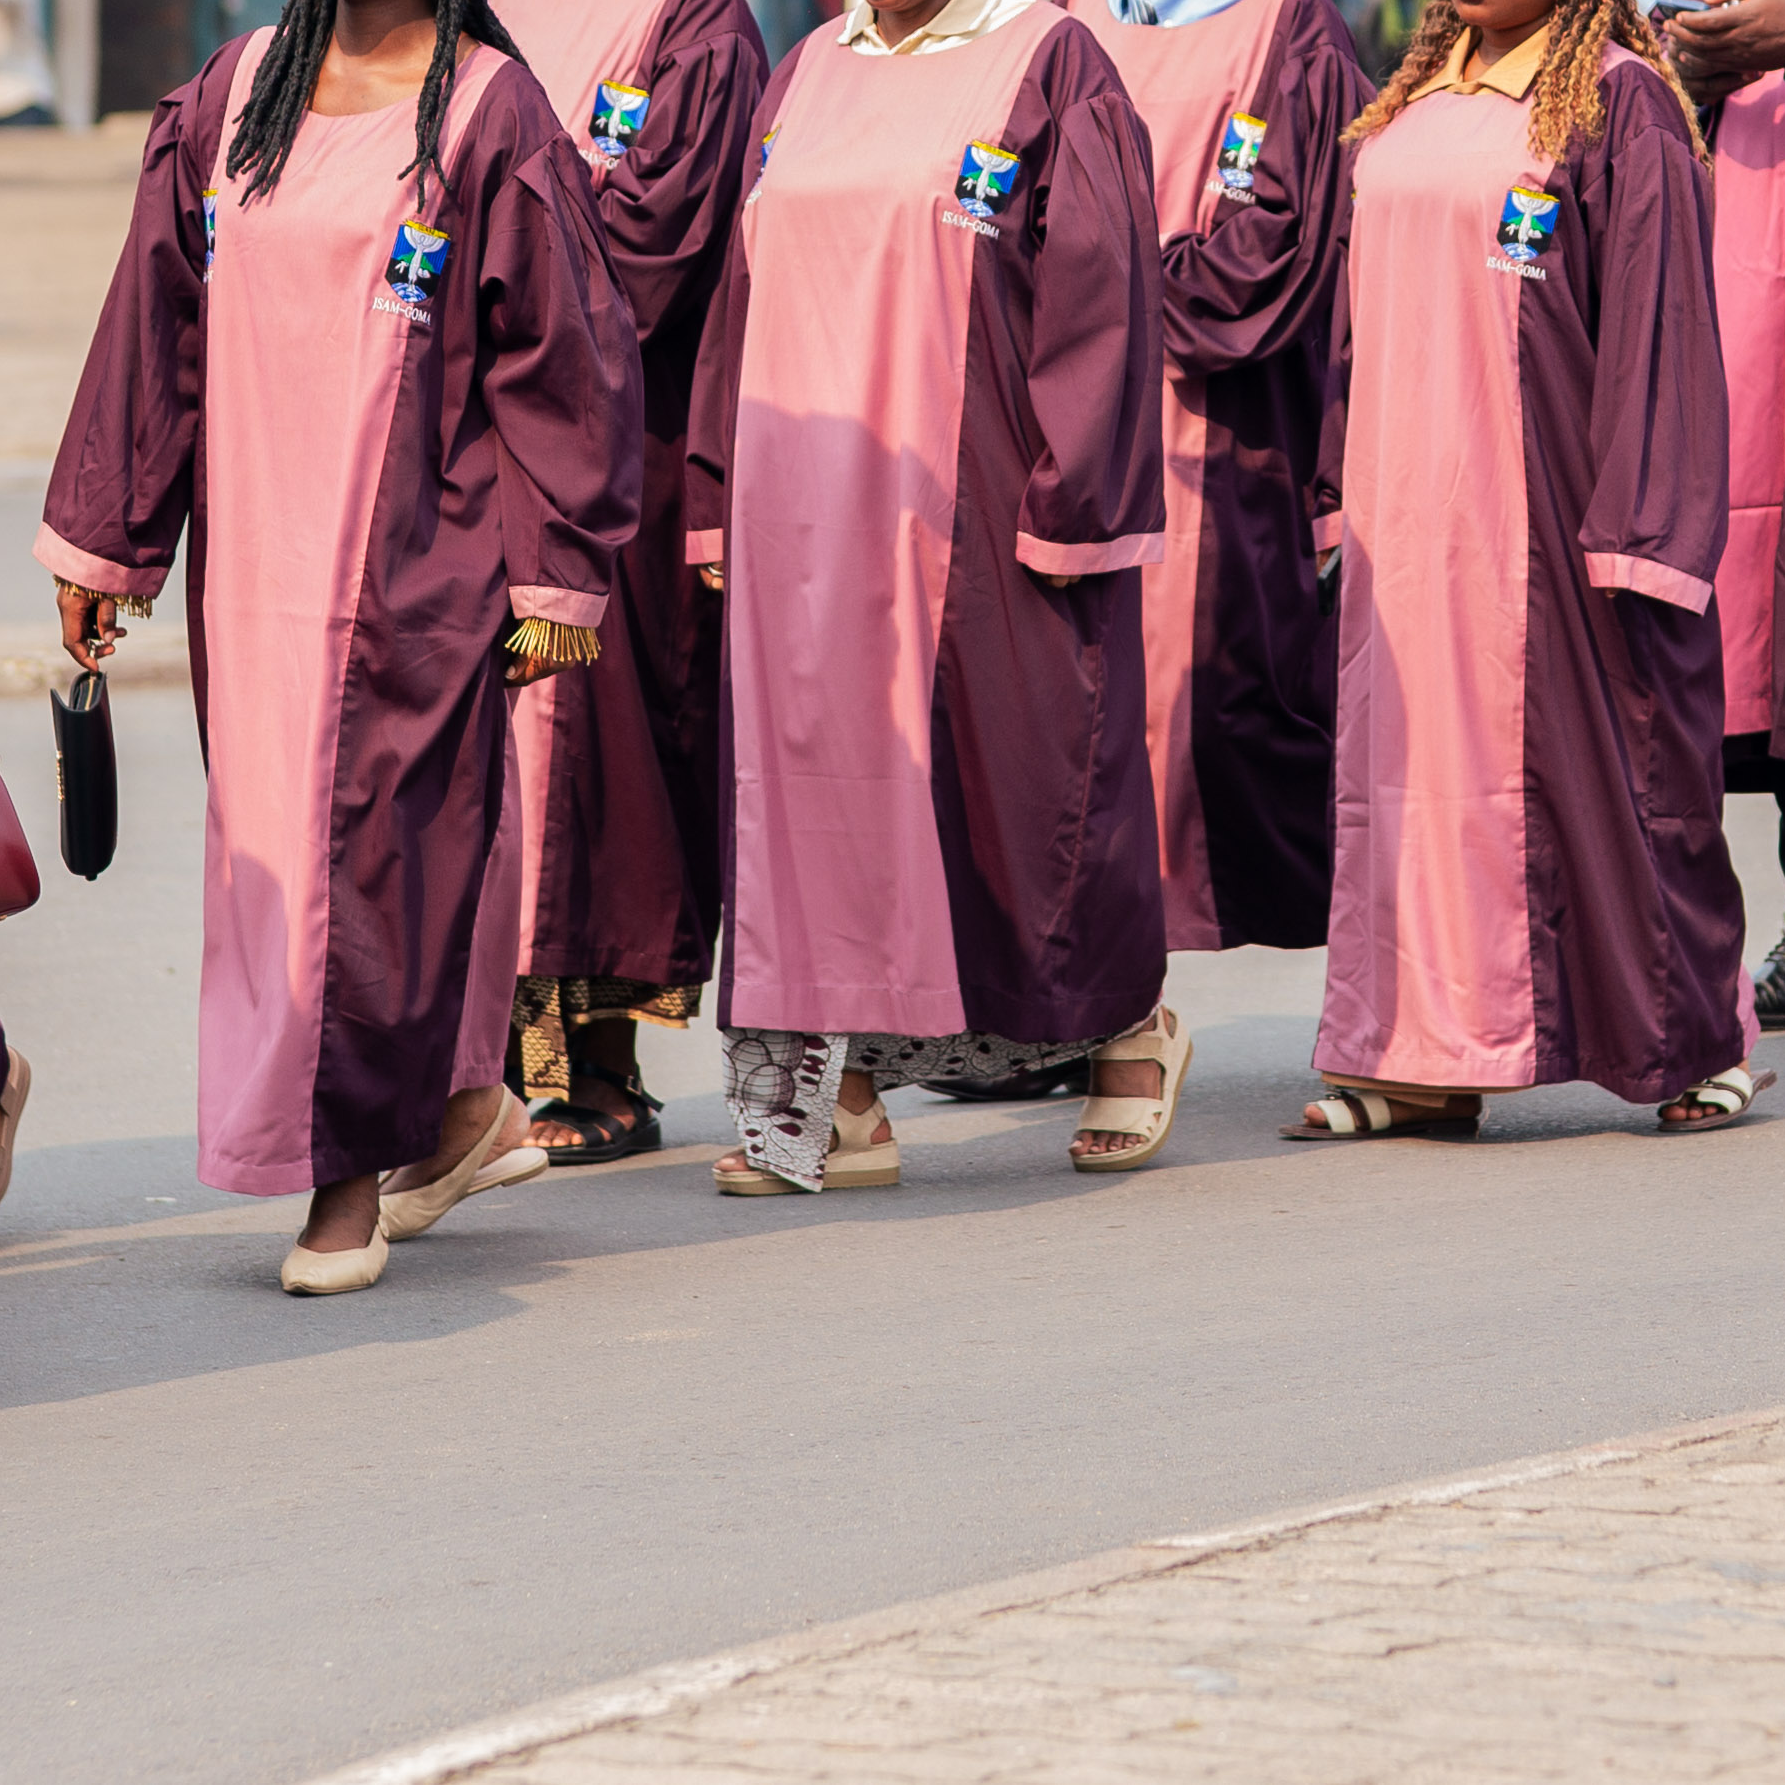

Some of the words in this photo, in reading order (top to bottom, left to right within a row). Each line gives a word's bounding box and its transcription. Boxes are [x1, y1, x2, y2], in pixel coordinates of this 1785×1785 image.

[941, 210, 1000, 240] ISAM-GOMA
[1486, 256, 1546, 281] ISAM-GOMA
[372, 297, 431, 326] ISAM-GOMA
